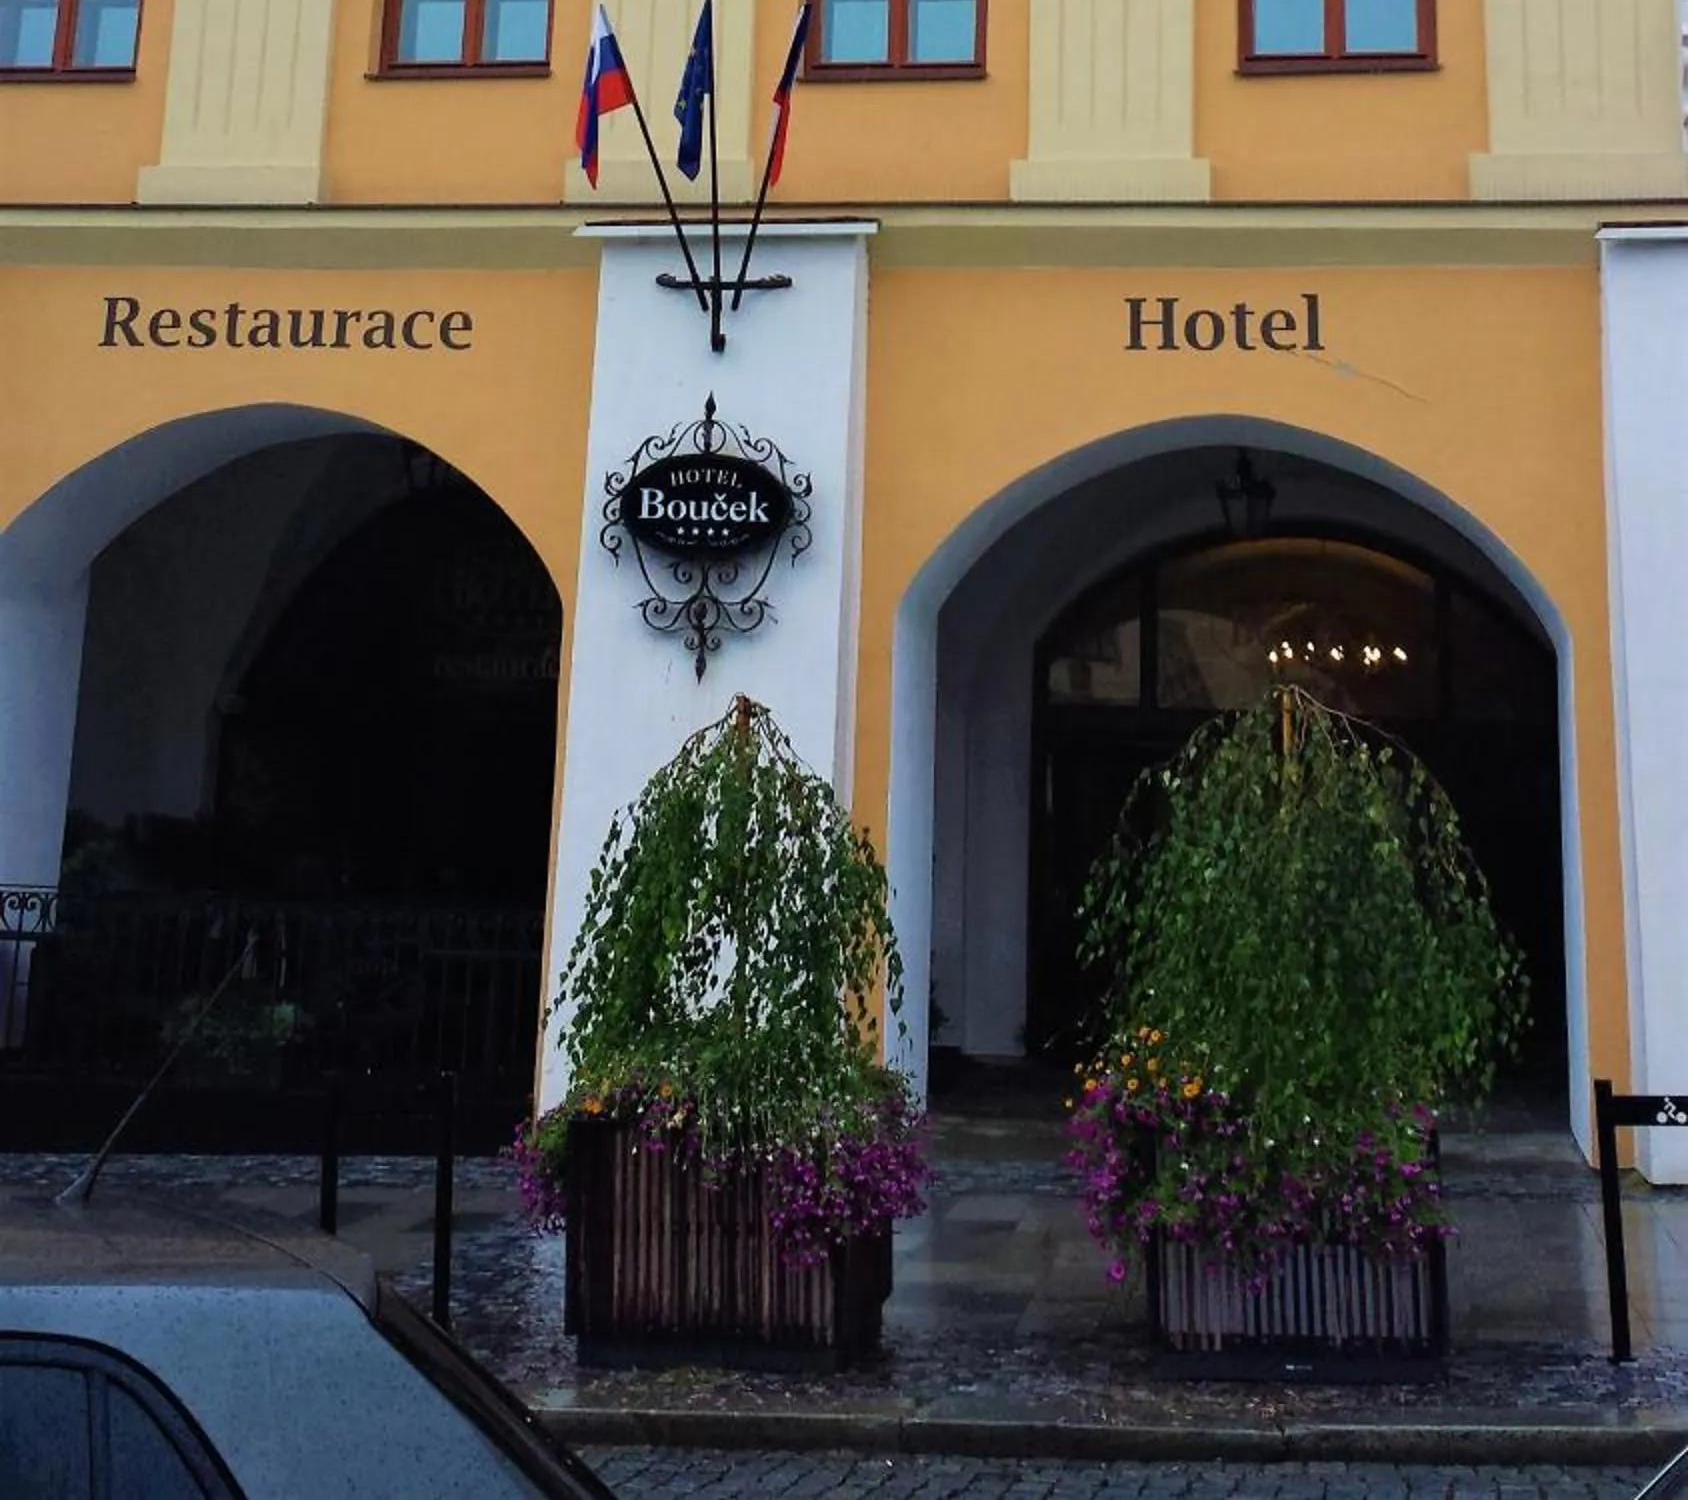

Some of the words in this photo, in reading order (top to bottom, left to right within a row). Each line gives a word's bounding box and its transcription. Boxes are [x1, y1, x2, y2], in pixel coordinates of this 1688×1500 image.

[98, 295, 473, 350] Restaurace
[1123, 293, 1326, 351] Hotel
[670, 467, 742, 488] HOTEL
[637, 487, 769, 523] Bouček
